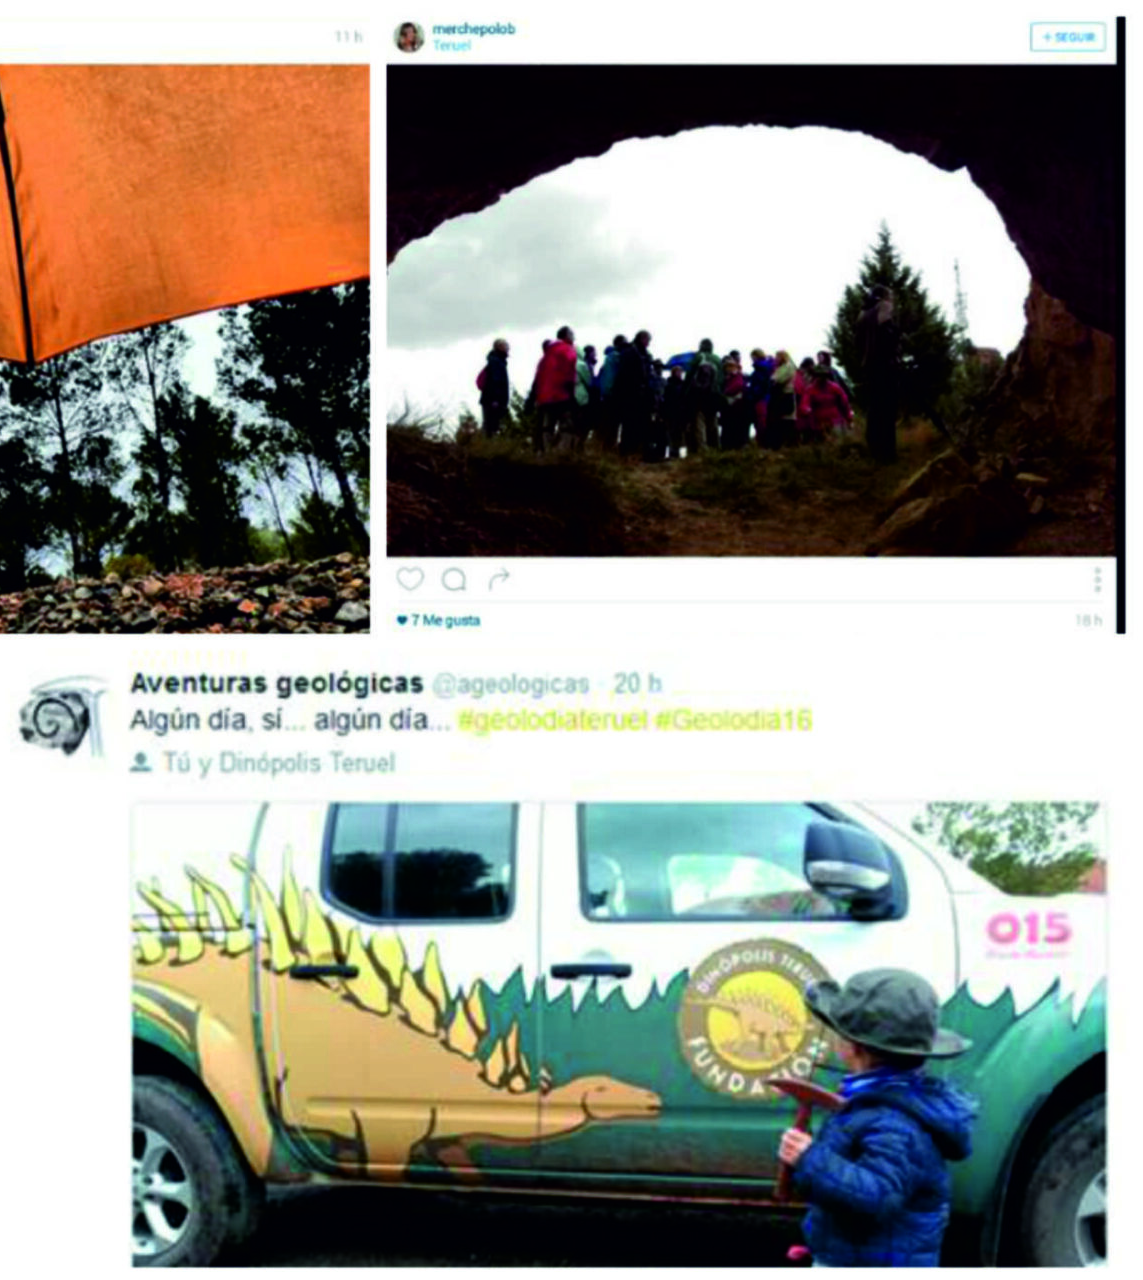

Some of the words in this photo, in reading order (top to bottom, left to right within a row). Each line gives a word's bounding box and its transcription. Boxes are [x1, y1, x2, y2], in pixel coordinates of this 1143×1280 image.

[335, 31, 349, 42] 11
[354, 30, 363, 42] h
[433, 22, 516, 37] merchepolob
[1055, 32, 1096, 42] SEGUIR
[433, 39, 472, 51] Teruel
[412, 613, 420, 626] 7
[423, 613, 443, 626] Me
[445, 615, 481, 629] gusta
[1076, 614, 1091, 626] 18
[1093, 613, 1103, 626] h
[131, 672, 268, 694] Aventuras
[276, 670, 424, 699] geológicas
[432, 672, 590, 699] @ageologicas
[614, 673, 640, 694] 20
[648, 673, 662, 693] h
[130, 708, 200, 736] Algún
[208, 707, 254, 732] día,
[262, 707, 307, 731] sí...
[314, 707, 381, 736] algún
[389, 707, 451, 731] día...
[656, 708, 813, 731] #Geolodia16
[165, 751, 191, 773] Tú
[199, 757, 211, 779] y
[220, 750, 321, 777] Dinópolis
[332, 751, 396, 773] Teruel
[988, 912, 1072, 944] 015
